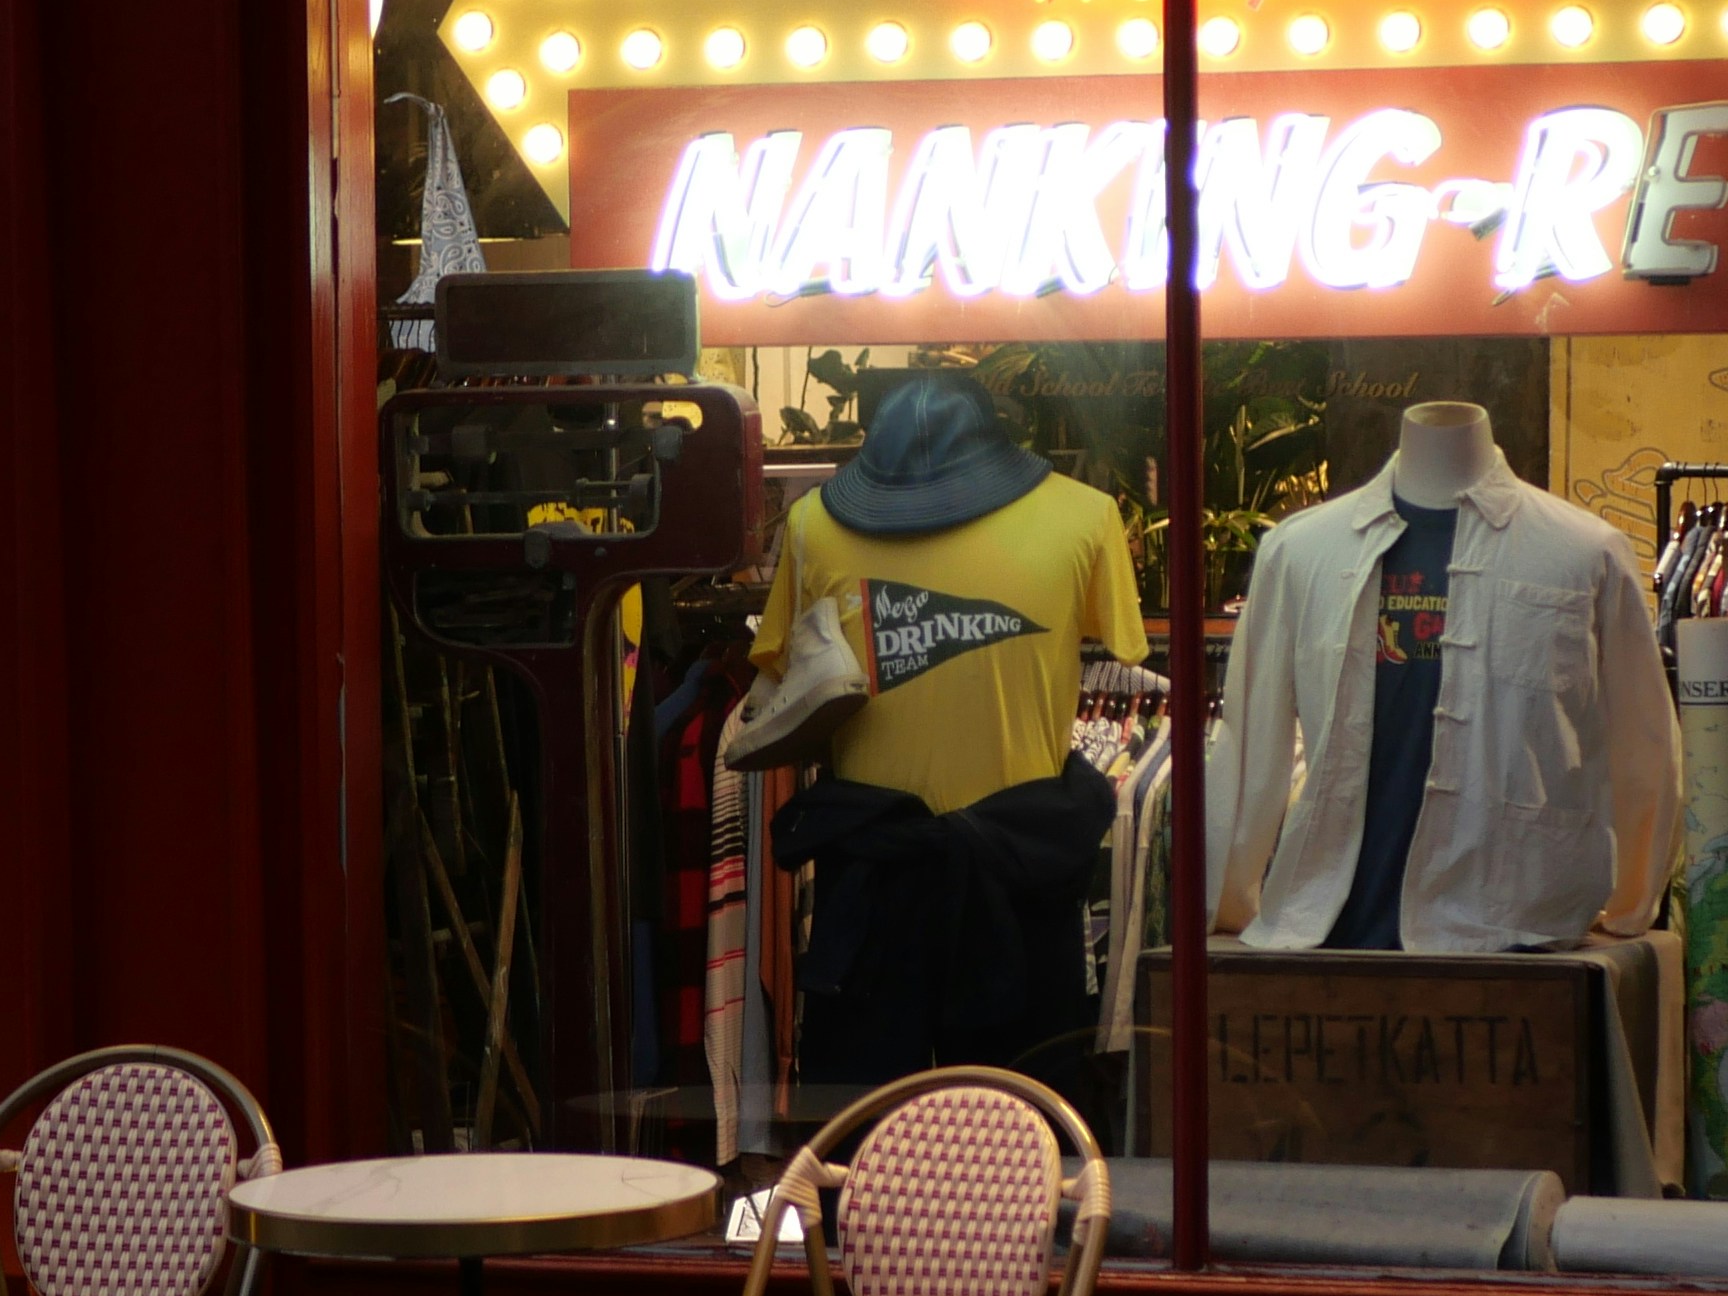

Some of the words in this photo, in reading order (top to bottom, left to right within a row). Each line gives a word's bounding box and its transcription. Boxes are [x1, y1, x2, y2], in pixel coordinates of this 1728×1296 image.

[1317, 369, 1421, 398] School
[1387, 595, 1449, 612] EDUCATIO
[876, 612, 1022, 657] DRINKING
[881, 653, 929, 681] TEAM
